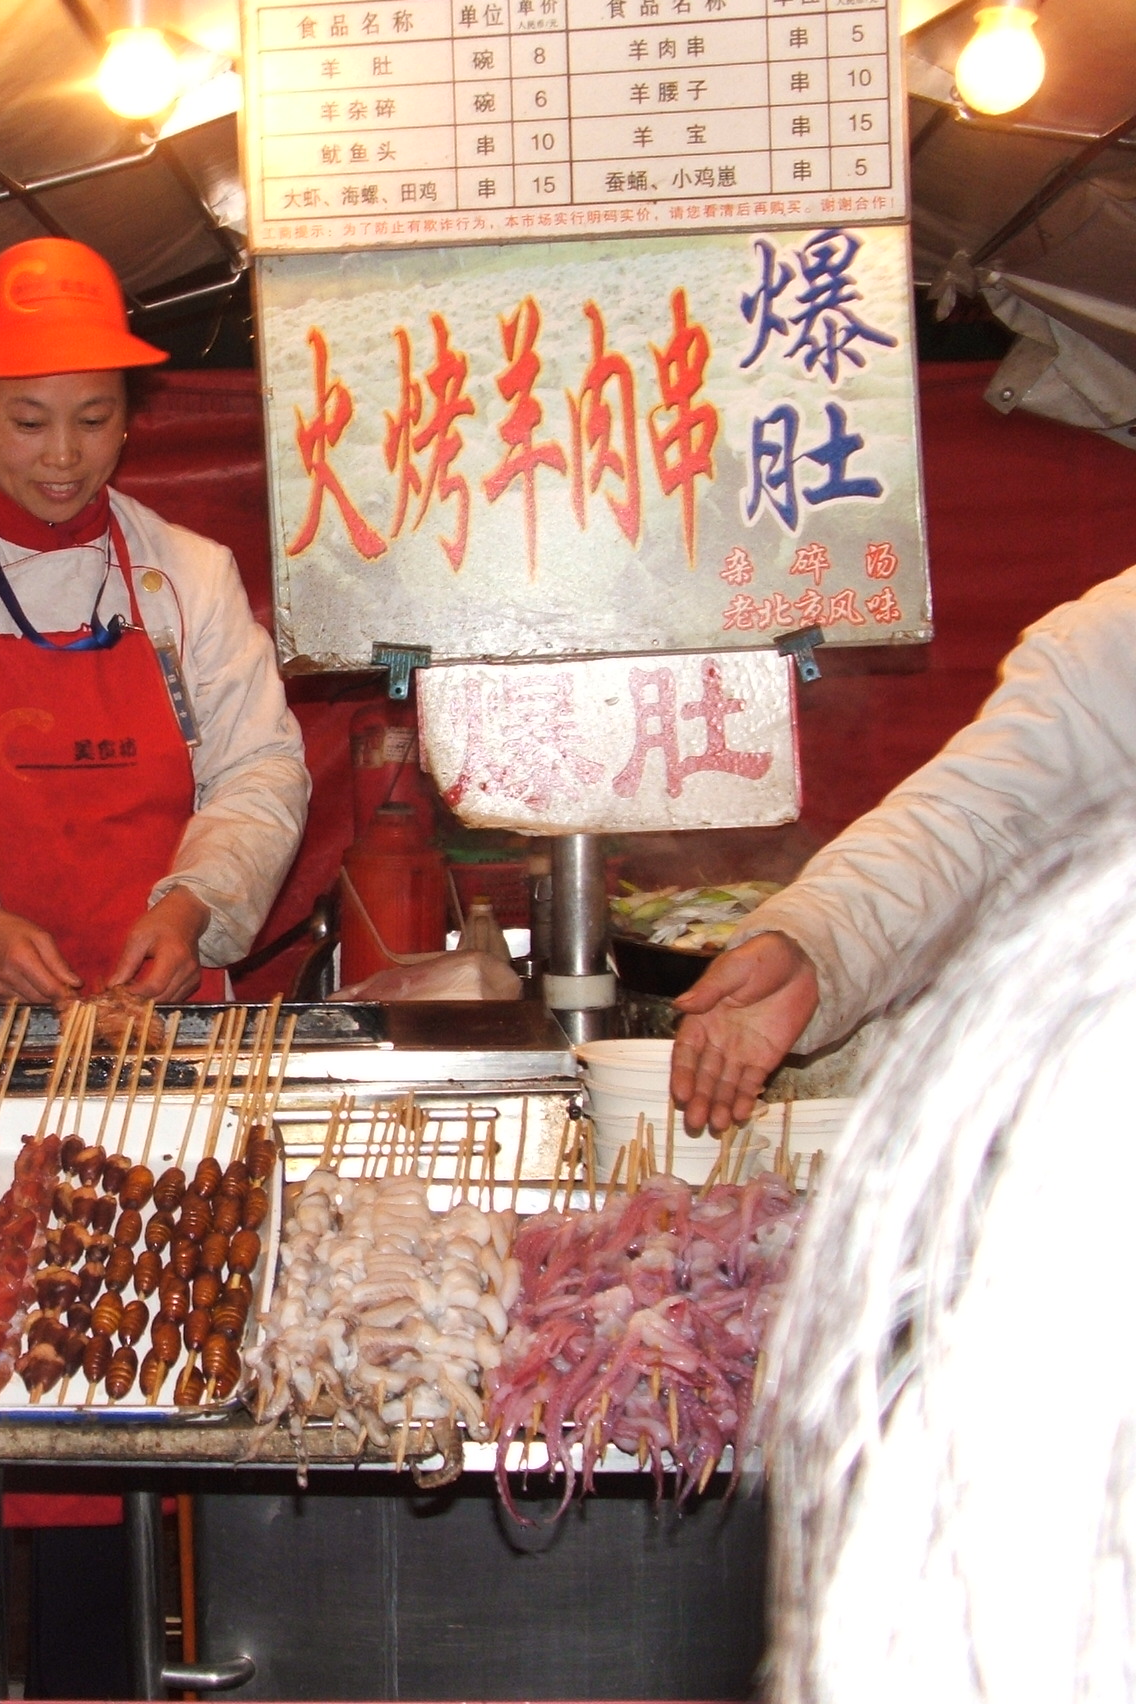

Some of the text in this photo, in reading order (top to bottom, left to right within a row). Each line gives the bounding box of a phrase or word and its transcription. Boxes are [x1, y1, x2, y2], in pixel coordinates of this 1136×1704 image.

[297, 10, 414, 39] 食品名称
[458, 4, 504, 28] 单位
[789, 27, 809, 49] 串
[851, 25, 865, 43] 5
[534, 47, 546, 64] 8
[629, 36, 706, 61] 羊肉串
[321, 55, 393, 79] 羊肚
[472, 50, 495, 71] 碗
[791, 71, 810, 94] 串
[847, 69, 873, 88] 10
[474, 92, 496, 113] 碗
[535, 91, 548, 108] 6
[630, 79, 708, 105] 羊腰子
[320, 98, 396, 122] 羊杂碎
[792, 115, 811, 138] 串
[849, 114, 873, 132] 15
[477, 135, 496, 157] 串
[531, 134, 555, 152] 10
[633, 124, 708, 149] 羊宝
[322, 141, 397, 165] 鱿鱼头
[605, 165, 738, 193] 蚕蛹、小鸡崽
[793, 160, 813, 182] 串
[855, 159, 868, 176] 5
[284, 181, 438, 209] 大虾、海螺、田鸡
[478, 178, 497, 200] 串
[533, 177, 557, 194] 15
[738, 227, 898, 532] 爆肚
[284, 286, 721, 584] 火烤羊肉串
[721, 543, 899, 586] 杂碎汤
[723, 586, 902, 630] 老北京风味
